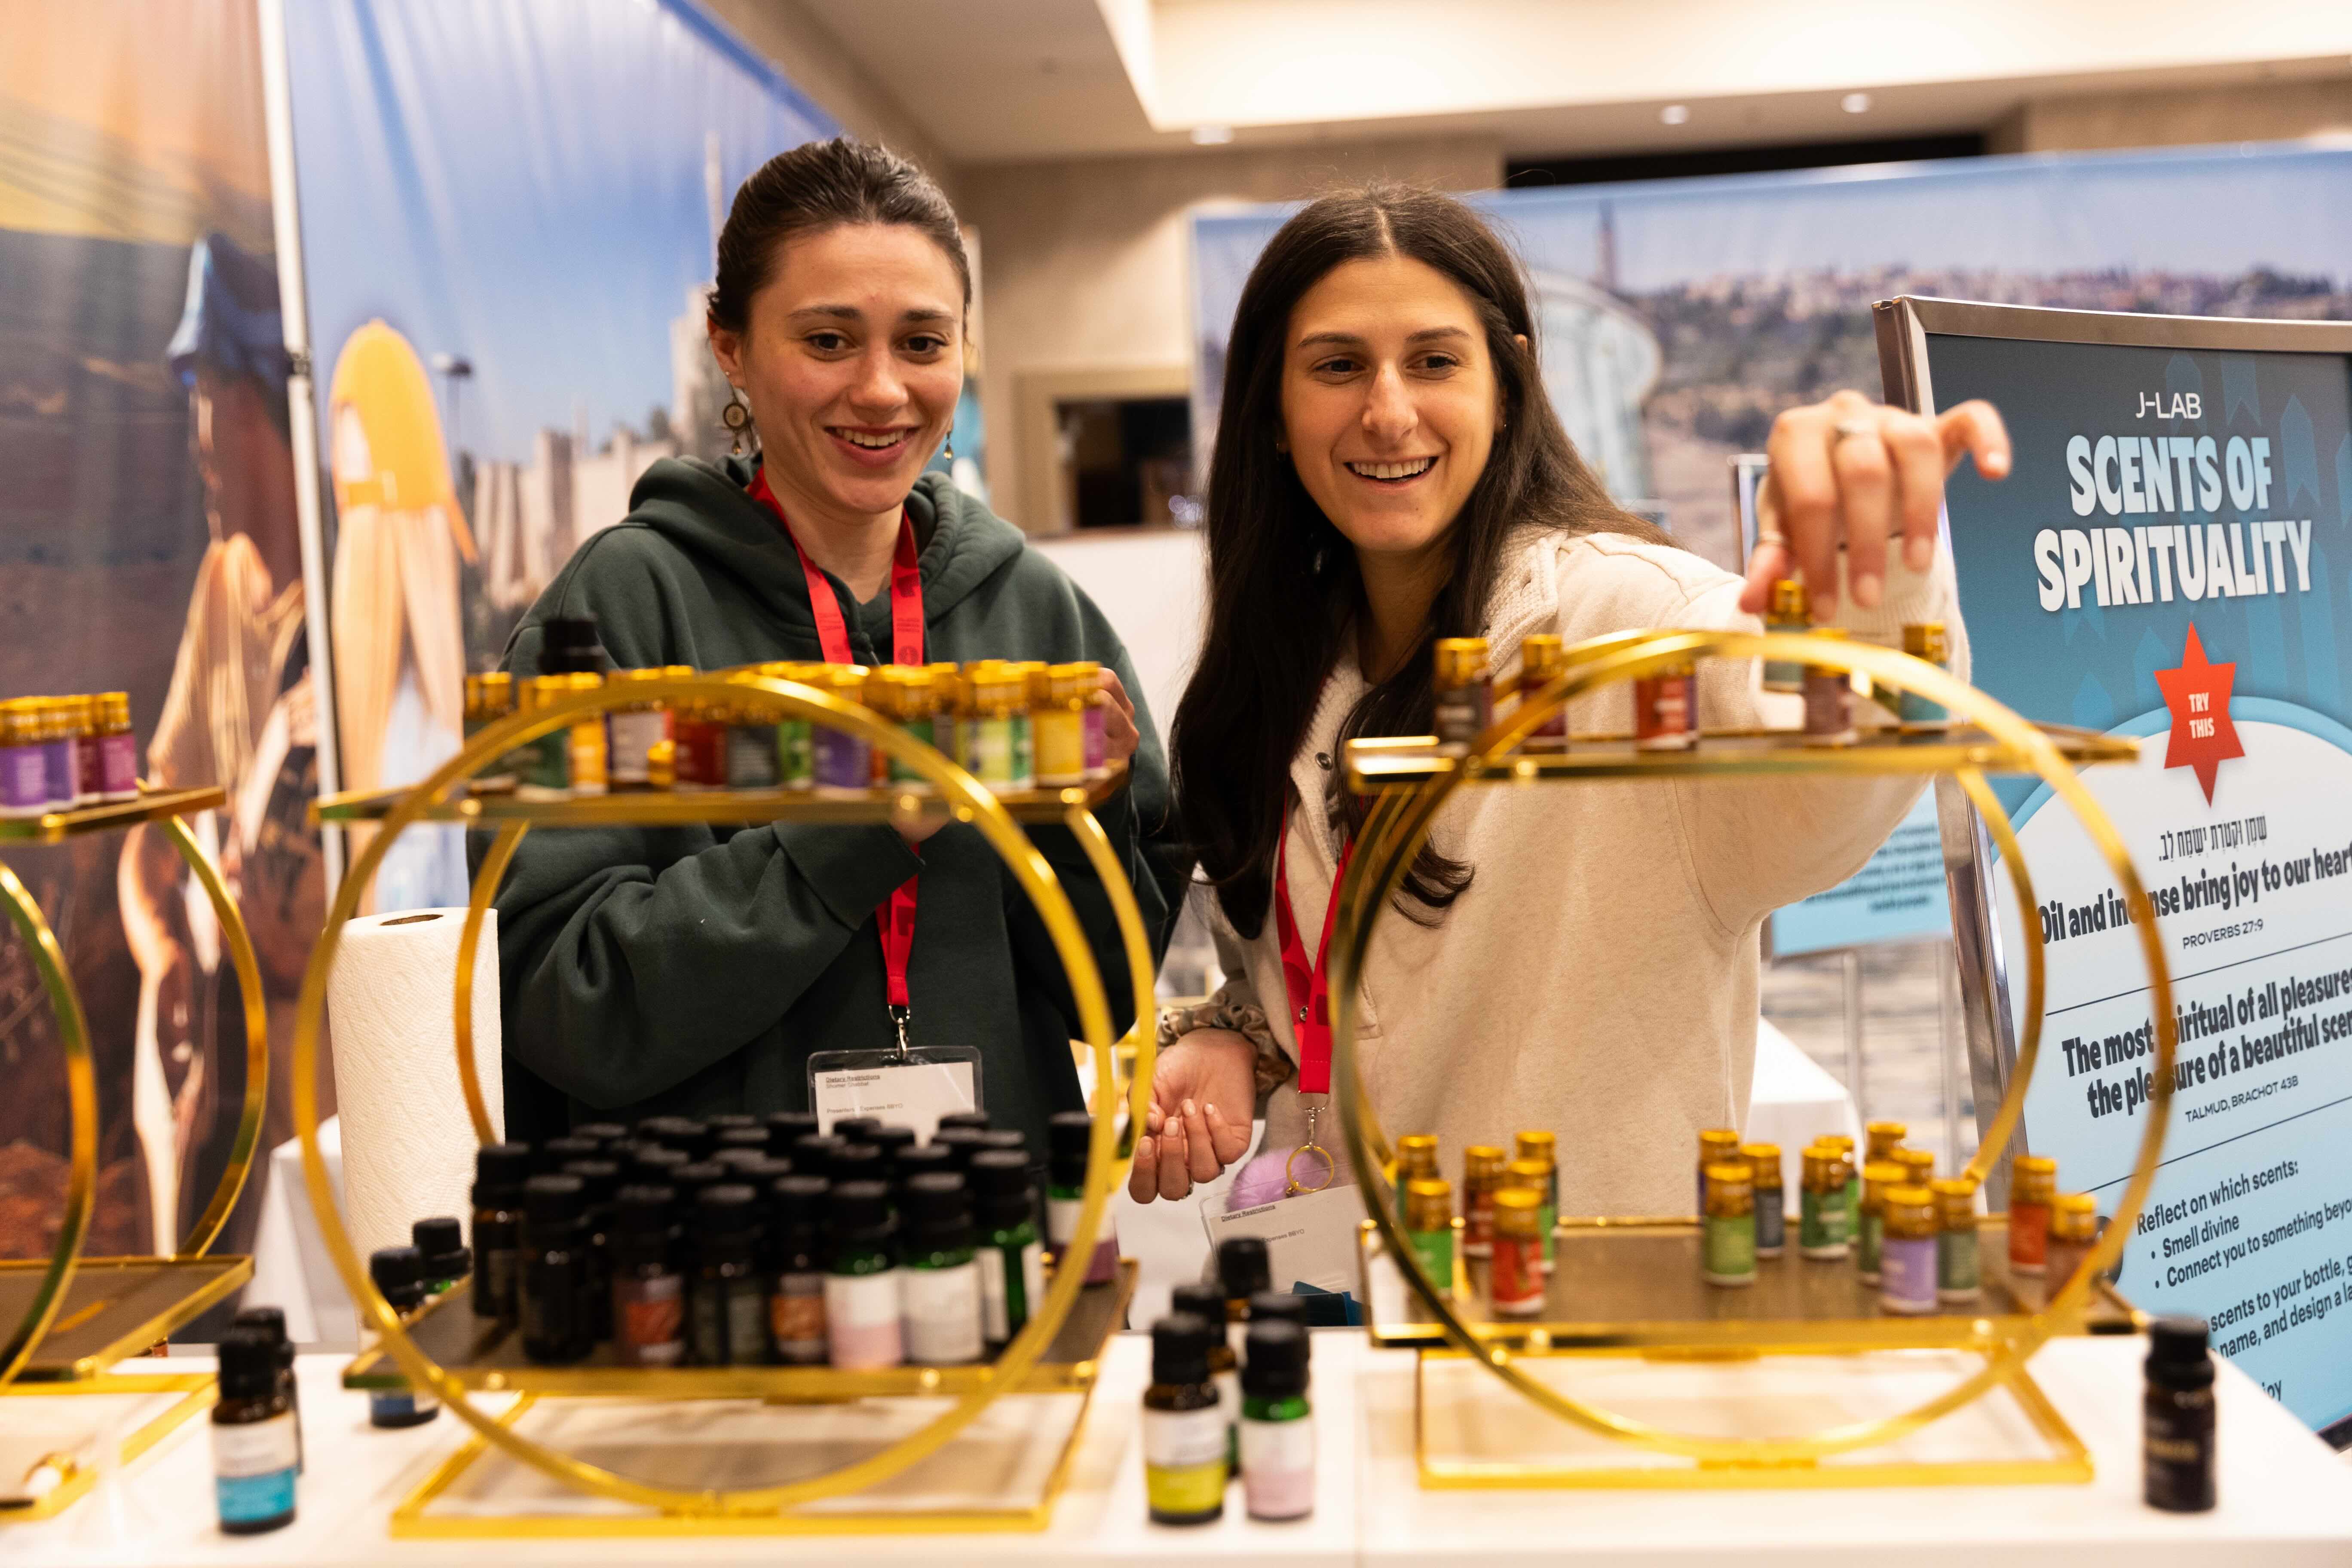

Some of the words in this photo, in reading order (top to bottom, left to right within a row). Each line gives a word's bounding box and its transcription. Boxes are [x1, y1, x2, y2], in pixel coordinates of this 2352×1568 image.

[2136, 392, 2202, 420] J-LAB
[2066, 435, 2222, 516] SCENTS
[2226, 435, 2272, 511] OF
[2034, 520, 2312, 612] SPIRITUALITY
[2189, 692, 2209, 713] TRY
[2189, 717, 2214, 738] THIS
[2037, 900, 2066, 944] Oil
[2069, 894, 2107, 938] and
[2107, 887, 2180, 928] incnse
[2181, 868, 2231, 910] bring
[2232, 862, 2258, 907] joy
[2261, 859, 2281, 891] to
[2284, 858, 2310, 886] our
[2183, 925, 2241, 949] PROVERBS
[2242, 919, 2263, 934] 27:9
[2061, 1036, 2101, 1077] The
[2104, 1016, 2154, 1066] most
[2237, 987, 2255, 1025] of
[2258, 982, 2278, 1020] all
[2281, 967, 2352, 1020] pleasure
[2087, 1079, 2122, 1118] the
[2208, 1040, 2226, 1080] of
[2229, 1046, 2240, 1073] a
[2241, 1013, 2319, 1069] beautiful
[2186, 1099, 2231, 1123] TALMUD,
[2232, 1082, 2278, 1108] BRACHOT
[2281, 1075, 2298, 1090] 43B
[1221, 1213, 1241, 1222] Dietary
[1242, 1204, 1276, 1217] Restrictions
[2137, 1199, 2187, 1236] Reflect
[2190, 1194, 2208, 1214] on
[2209, 1173, 2251, 1206] which
[2252, 1161, 2299, 1190] scents:
[2163, 1225, 2199, 1258] Smell
[2201, 1214, 2240, 1243] divine
[2167, 1250, 2222, 1287] Connect
[2223, 1244, 2246, 1268] you
[2247, 1236, 2260, 1254] to
[2262, 1210, 2324, 1248] something
[2211, 1298, 2255, 1332] scents
[2257, 1292, 2271, 1311] to
[2272, 1277, 2301, 1308] your
[2303, 1258, 2345, 1290] bottle,
[2220, 1329, 2261, 1358] name,
[2263, 1310, 2288, 1340] and
[2290, 1296, 2332, 1327] design
[2334, 1290, 2342, 1307] a
